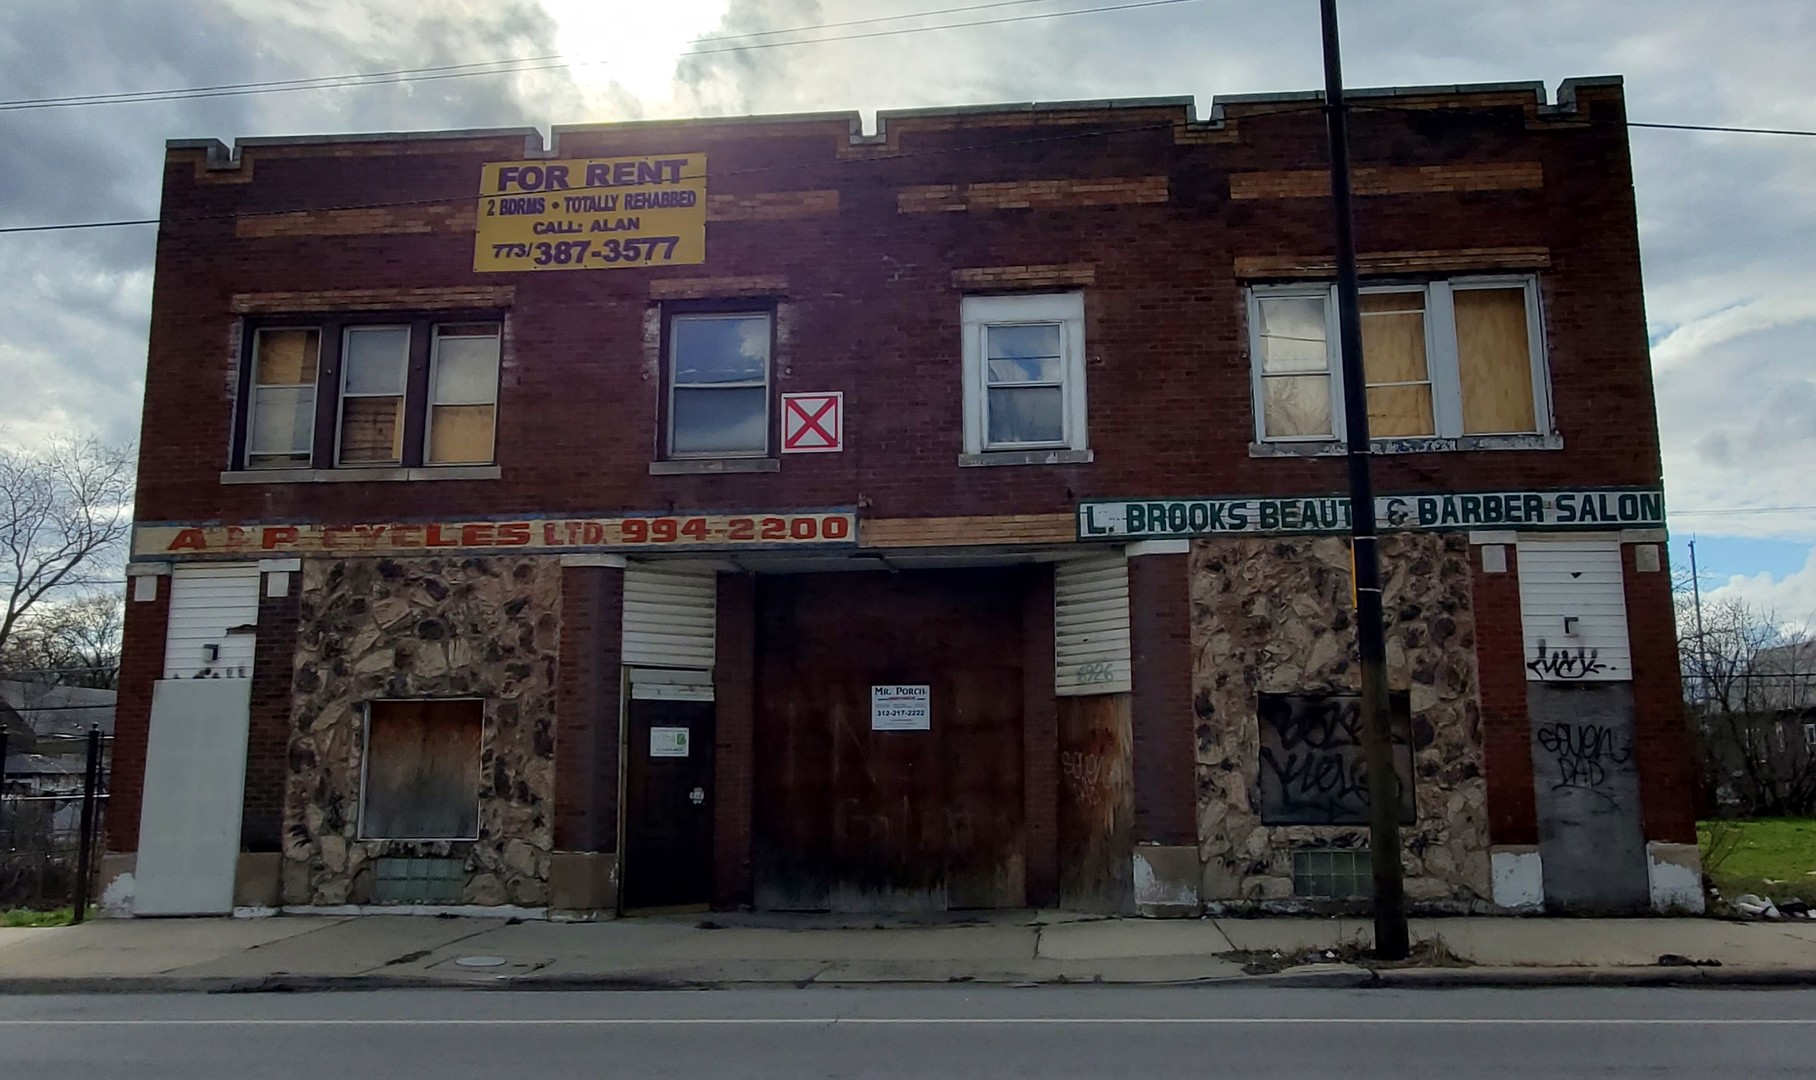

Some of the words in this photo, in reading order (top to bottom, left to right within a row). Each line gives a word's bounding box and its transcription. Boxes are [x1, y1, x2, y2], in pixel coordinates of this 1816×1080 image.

[498, 165, 570, 192] FOR
[585, 158, 688, 186] RENT
[487, 199, 496, 217] 2
[499, 197, 546, 215] BDRMS
[564, 194, 619, 213] TOTALLY
[624, 190, 697, 210] REHABBED
[590, 217, 641, 232] ALAN
[1126, 502, 1248, 533] BROOKS
[1259, 499, 1353, 530] BEAUT
[1417, 493, 1545, 526] BARBER
[1556, 493, 1662, 522] SALON
[621, 516, 849, 544] 994-2200
